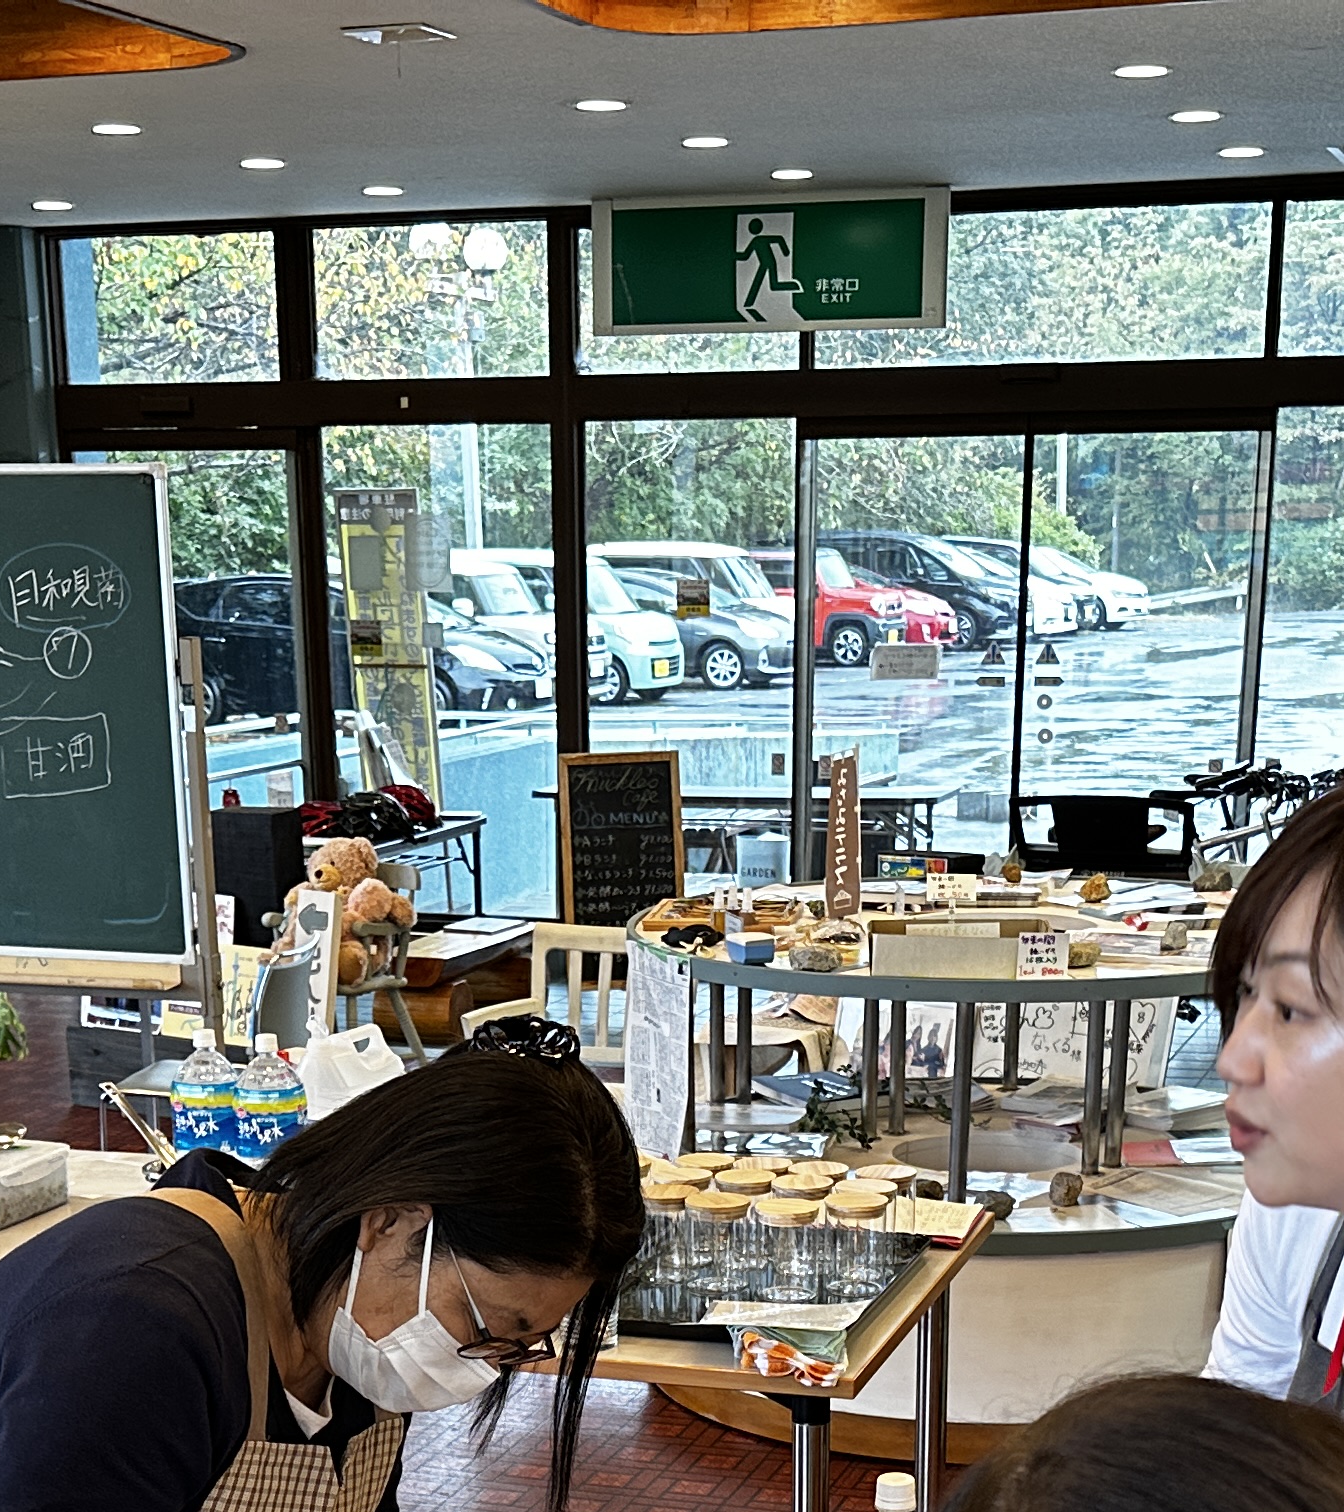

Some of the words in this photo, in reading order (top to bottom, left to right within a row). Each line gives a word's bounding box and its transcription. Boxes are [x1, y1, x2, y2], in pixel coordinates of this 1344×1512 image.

[815, 278, 859, 292] 非常口
[821, 293, 852, 304] EXIT
[23, 733, 94, 780] 甘酒
[609, 811, 654, 824] MENU
